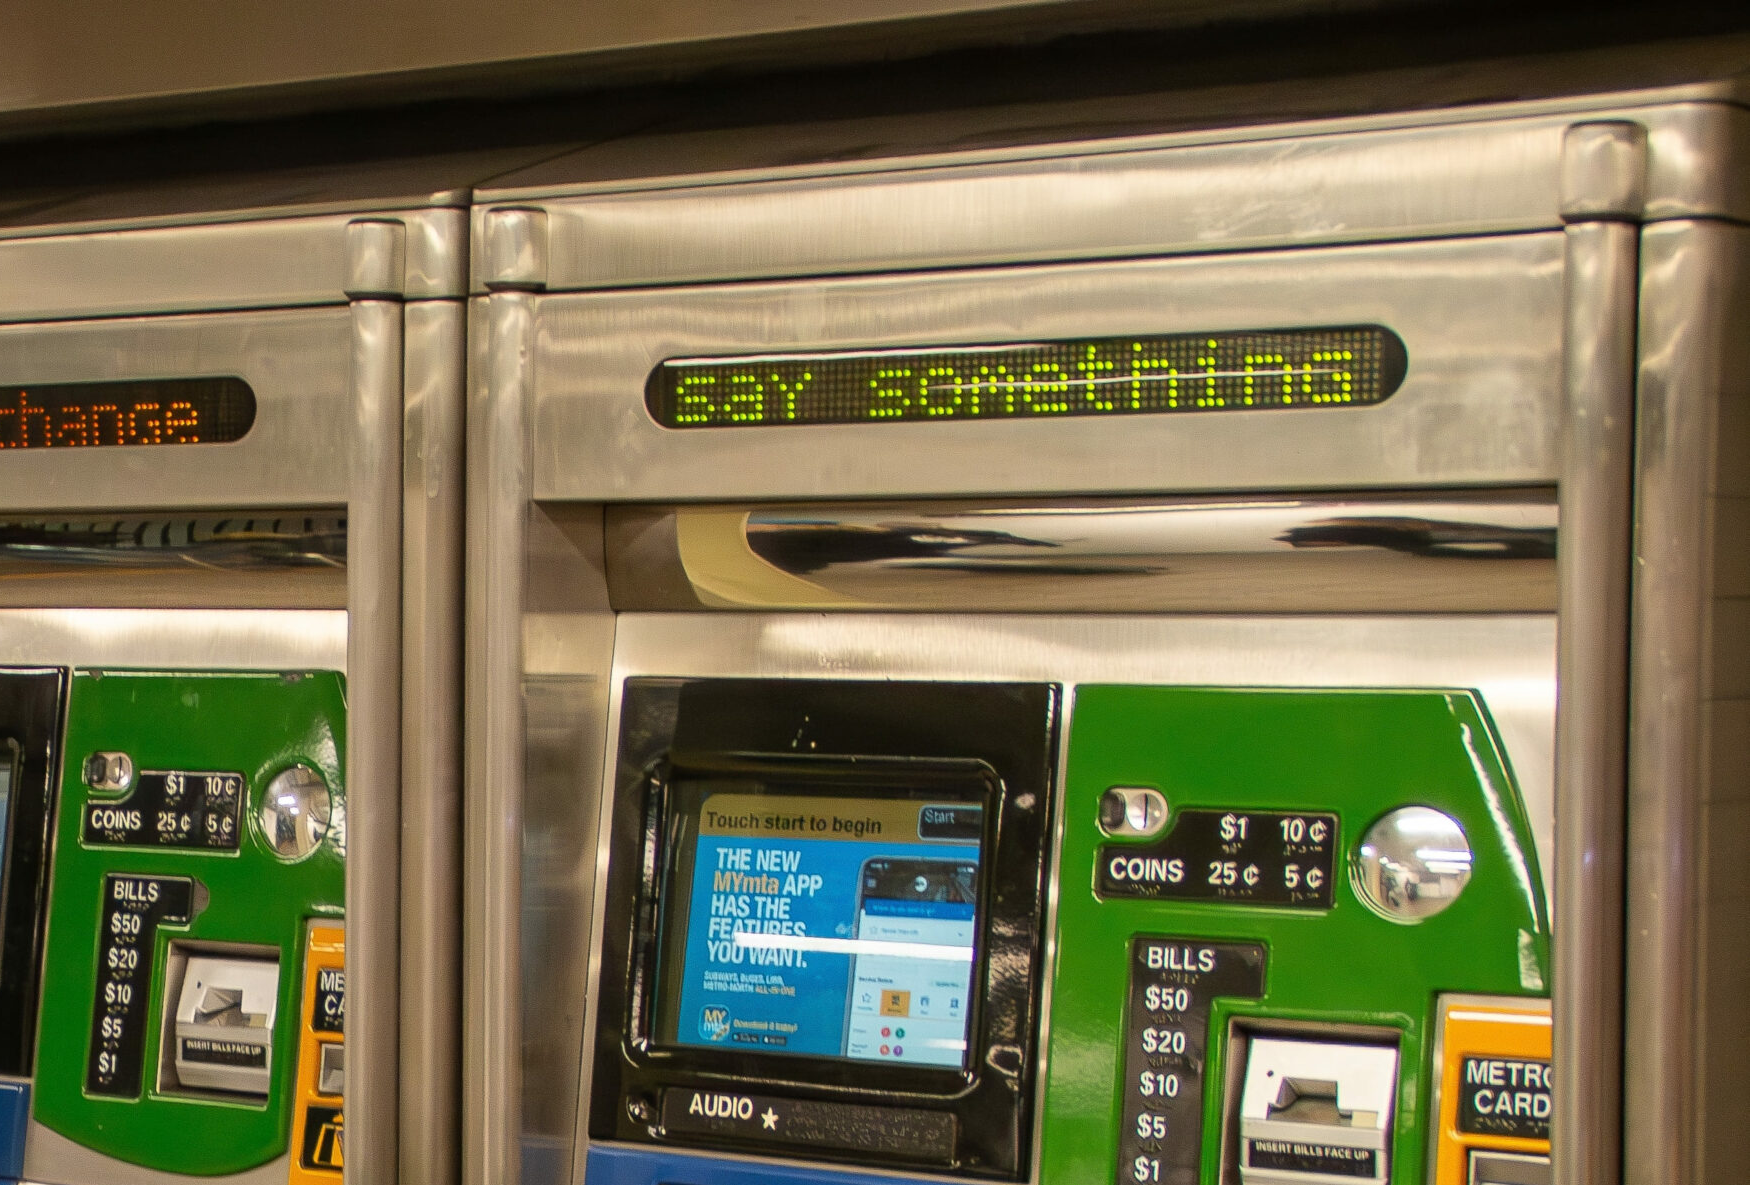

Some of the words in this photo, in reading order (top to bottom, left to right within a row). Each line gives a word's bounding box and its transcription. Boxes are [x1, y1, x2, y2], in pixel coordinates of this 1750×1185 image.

[166, 775, 185, 795] $1
[92, 809, 141, 831] COINS
[707, 811, 759, 829] Touch
[764, 813, 805, 831] start
[810, 815, 827, 832] to
[832, 816, 882, 838] begin
[924, 808, 956, 825] Start
[1219, 813, 1249, 841] $1
[716, 847, 752, 871] THE
[756, 849, 801, 873] NEW
[1109, 856, 1184, 883] COINS
[114, 880, 160, 902] BILLS
[713, 869, 779, 894] MYmta
[782, 874, 823, 897] APP
[711, 894, 750, 918] HAS
[755, 896, 791, 919] THE
[111, 912, 140, 934] $50
[708, 917, 807, 939] FEATURES
[108, 946, 137, 970] $20
[707, 939, 745, 964] YOU
[1147, 946, 1215, 972] BILLS
[105, 981, 131, 1005] $10
[1145, 984, 1188, 1012] $50
[102, 1016, 122, 1039] $5
[1142, 1027, 1186, 1054] $20
[99, 1051, 116, 1073] $1
[1139, 1071, 1179, 1097] $10
[689, 1092, 753, 1120] AUDIO
[1474, 1089, 1551, 1118] CARD
[1137, 1113, 1166, 1139] $5
[1255, 1141, 1291, 1154] INSERT
[1134, 1155, 1161, 1182] $1
